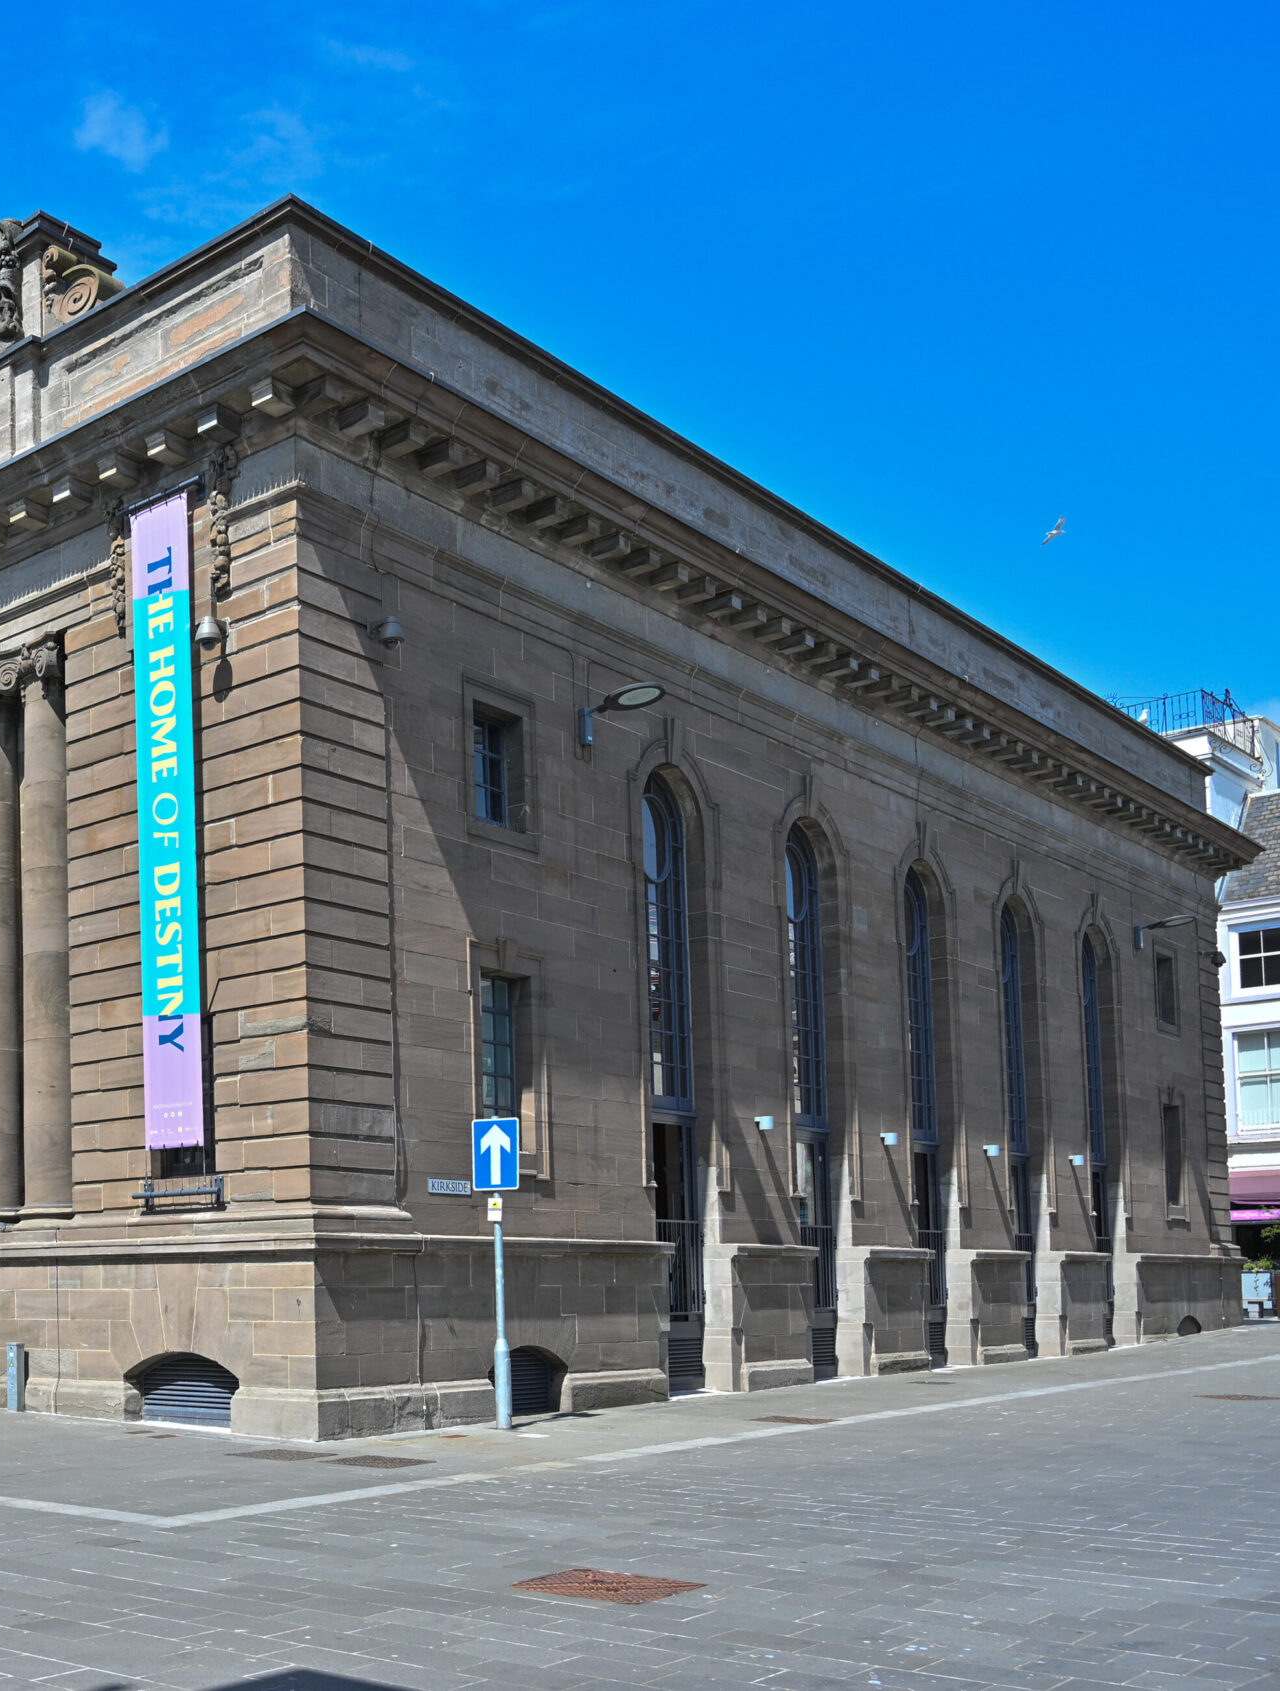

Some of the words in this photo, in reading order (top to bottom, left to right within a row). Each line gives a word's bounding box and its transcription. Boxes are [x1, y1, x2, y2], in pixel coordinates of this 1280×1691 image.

[147, 546, 174, 639] THE
[149, 644, 178, 783] HOME
[152, 792, 179, 848] OF
[154, 861, 185, 1052] DESTINY
[431, 1180, 468, 1192] KIRKSIDE
